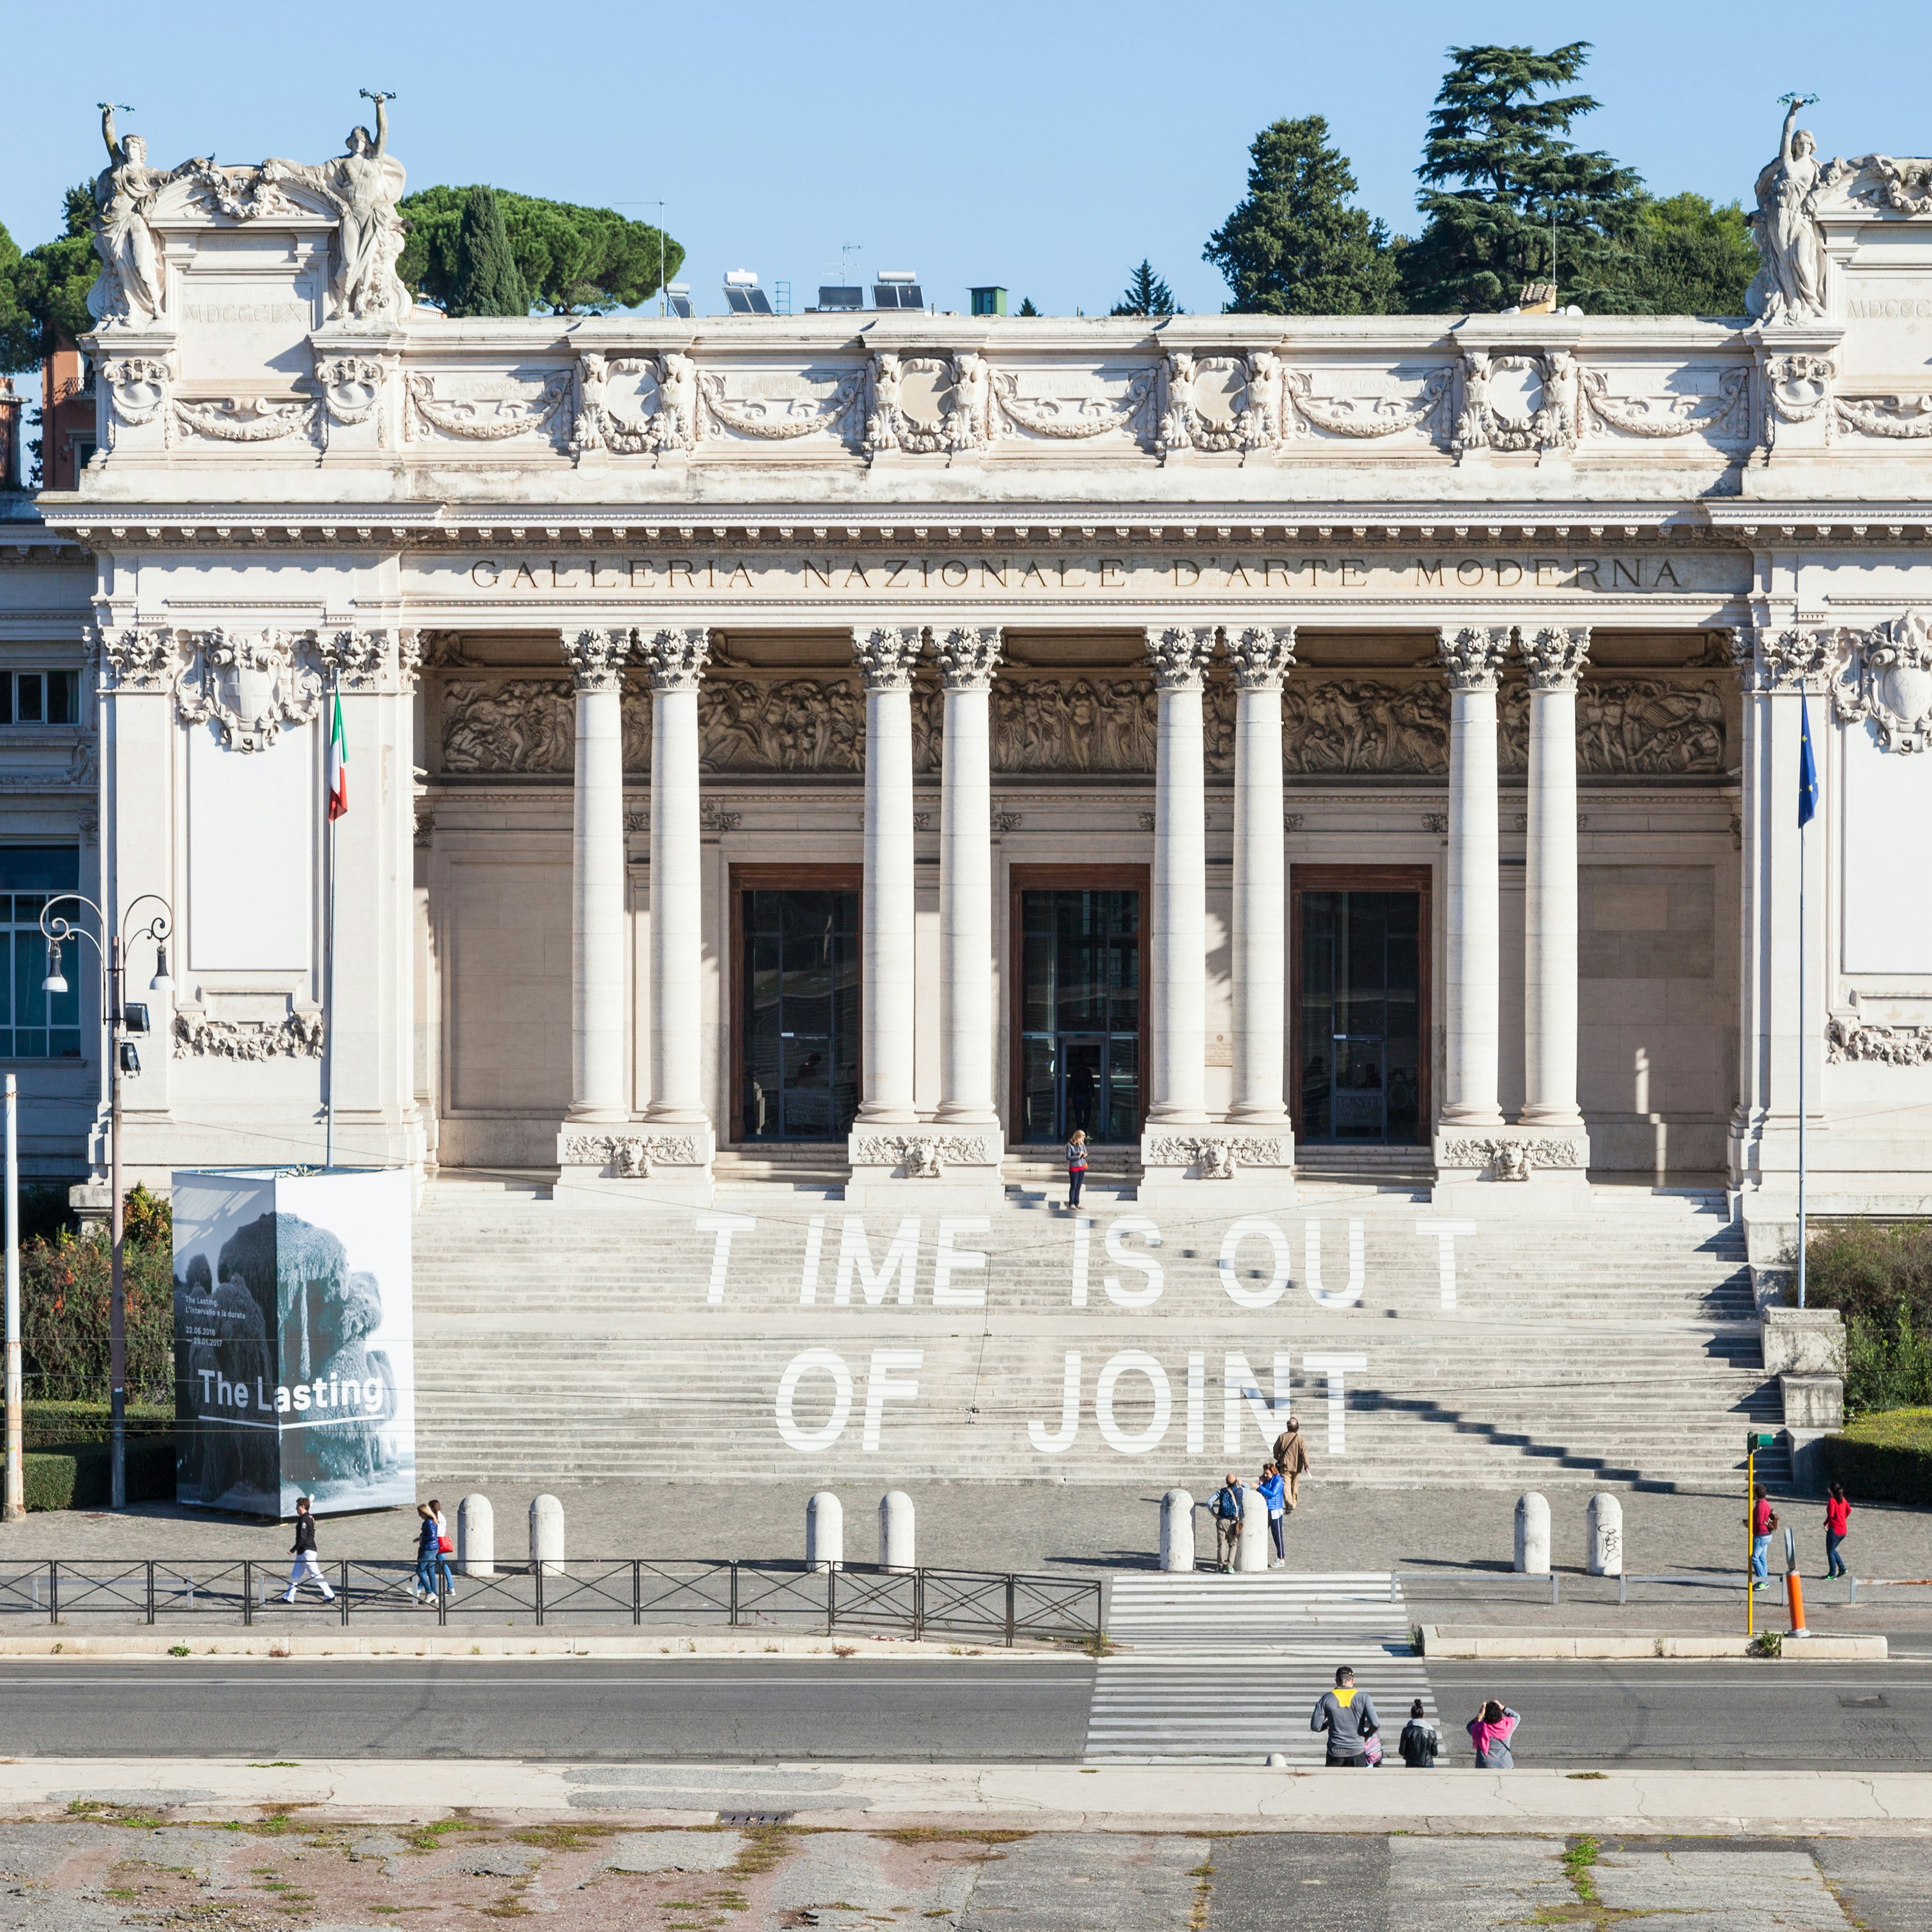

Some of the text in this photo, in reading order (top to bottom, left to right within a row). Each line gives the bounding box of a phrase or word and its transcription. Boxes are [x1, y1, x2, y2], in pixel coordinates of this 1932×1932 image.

[1847, 299, 1932, 318] MDCCC
[455, 381, 522, 392] LEONARDO
[745, 381, 817, 392] RAFFAELLO
[1024, 380, 1122, 390] MICHELANGELO
[1337, 379, 1397, 389] BERNINI
[1635, 379, 1692, 389] CANOVA
[471, 557, 1682, 588] GALLERIA NAZIONALE D'ARTE MODERNA
[695, 1215, 1477, 1310] TIME IS OUT
[197, 1297, 219, 1307] Lasting.
[185, 1307, 216, 1316] L'intervallo
[185, 1326, 216, 1336] 22.06.2016
[193, 1337, 222, 1347] 29.01.2017
[198, 1369, 384, 1413] The Lasting
[775, 1347, 1368, 1454] OF JOINT
